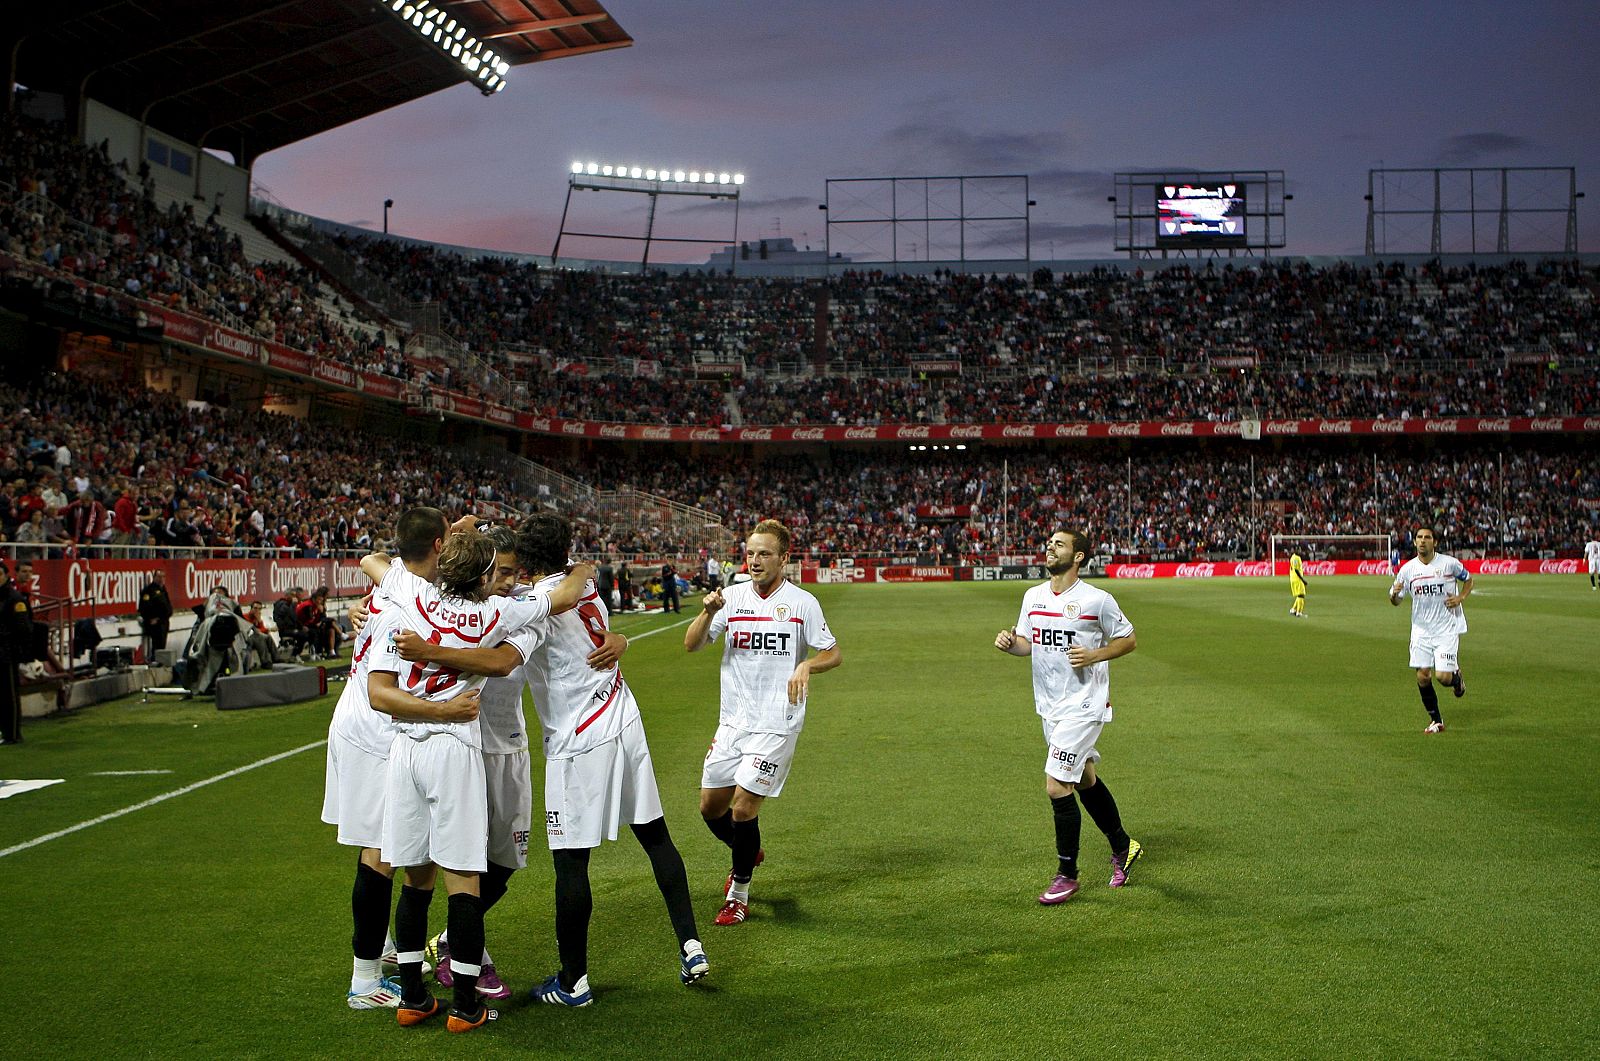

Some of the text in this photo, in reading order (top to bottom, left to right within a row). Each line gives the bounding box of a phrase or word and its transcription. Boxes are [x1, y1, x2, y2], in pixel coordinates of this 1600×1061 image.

[563, 420, 585, 434] Coca-Cola
[600, 424, 625, 438] Coca-Cola
[1003, 424, 1036, 437] Coca-Cola
[1056, 424, 1088, 436] Coca-Cola
[1108, 424, 1140, 436] Coca-Cola
[1161, 423, 1194, 436] Coca-Cola
[1266, 420, 1299, 434] Coca-Cola
[1319, 420, 1352, 433] Coca-Cola
[1372, 420, 1405, 432] Coca-Cola
[1425, 419, 1458, 432] Coca-Cola
[1477, 418, 1510, 432] Coca-Cola
[1530, 418, 1563, 431] Coca-Cola
[643, 425, 671, 439] Coca-Cola
[740, 428, 772, 440] Coca-Cola
[792, 427, 825, 440] Coca-Cola
[845, 426, 877, 439] Coca-Cola
[898, 426, 930, 438] Coca-Cola
[950, 425, 983, 438] Coca-Cola
[1116, 564, 1156, 578] Coca-Cola
[1176, 563, 1215, 578] Coca-Cola
[1480, 560, 1519, 574] Coca-Cola
[1539, 559, 1578, 574] Coca-Cola
[186, 562, 248, 603] Cruzcampo
[271, 561, 319, 597] Cruzcampo
[732, 631, 791, 651] 12BET
